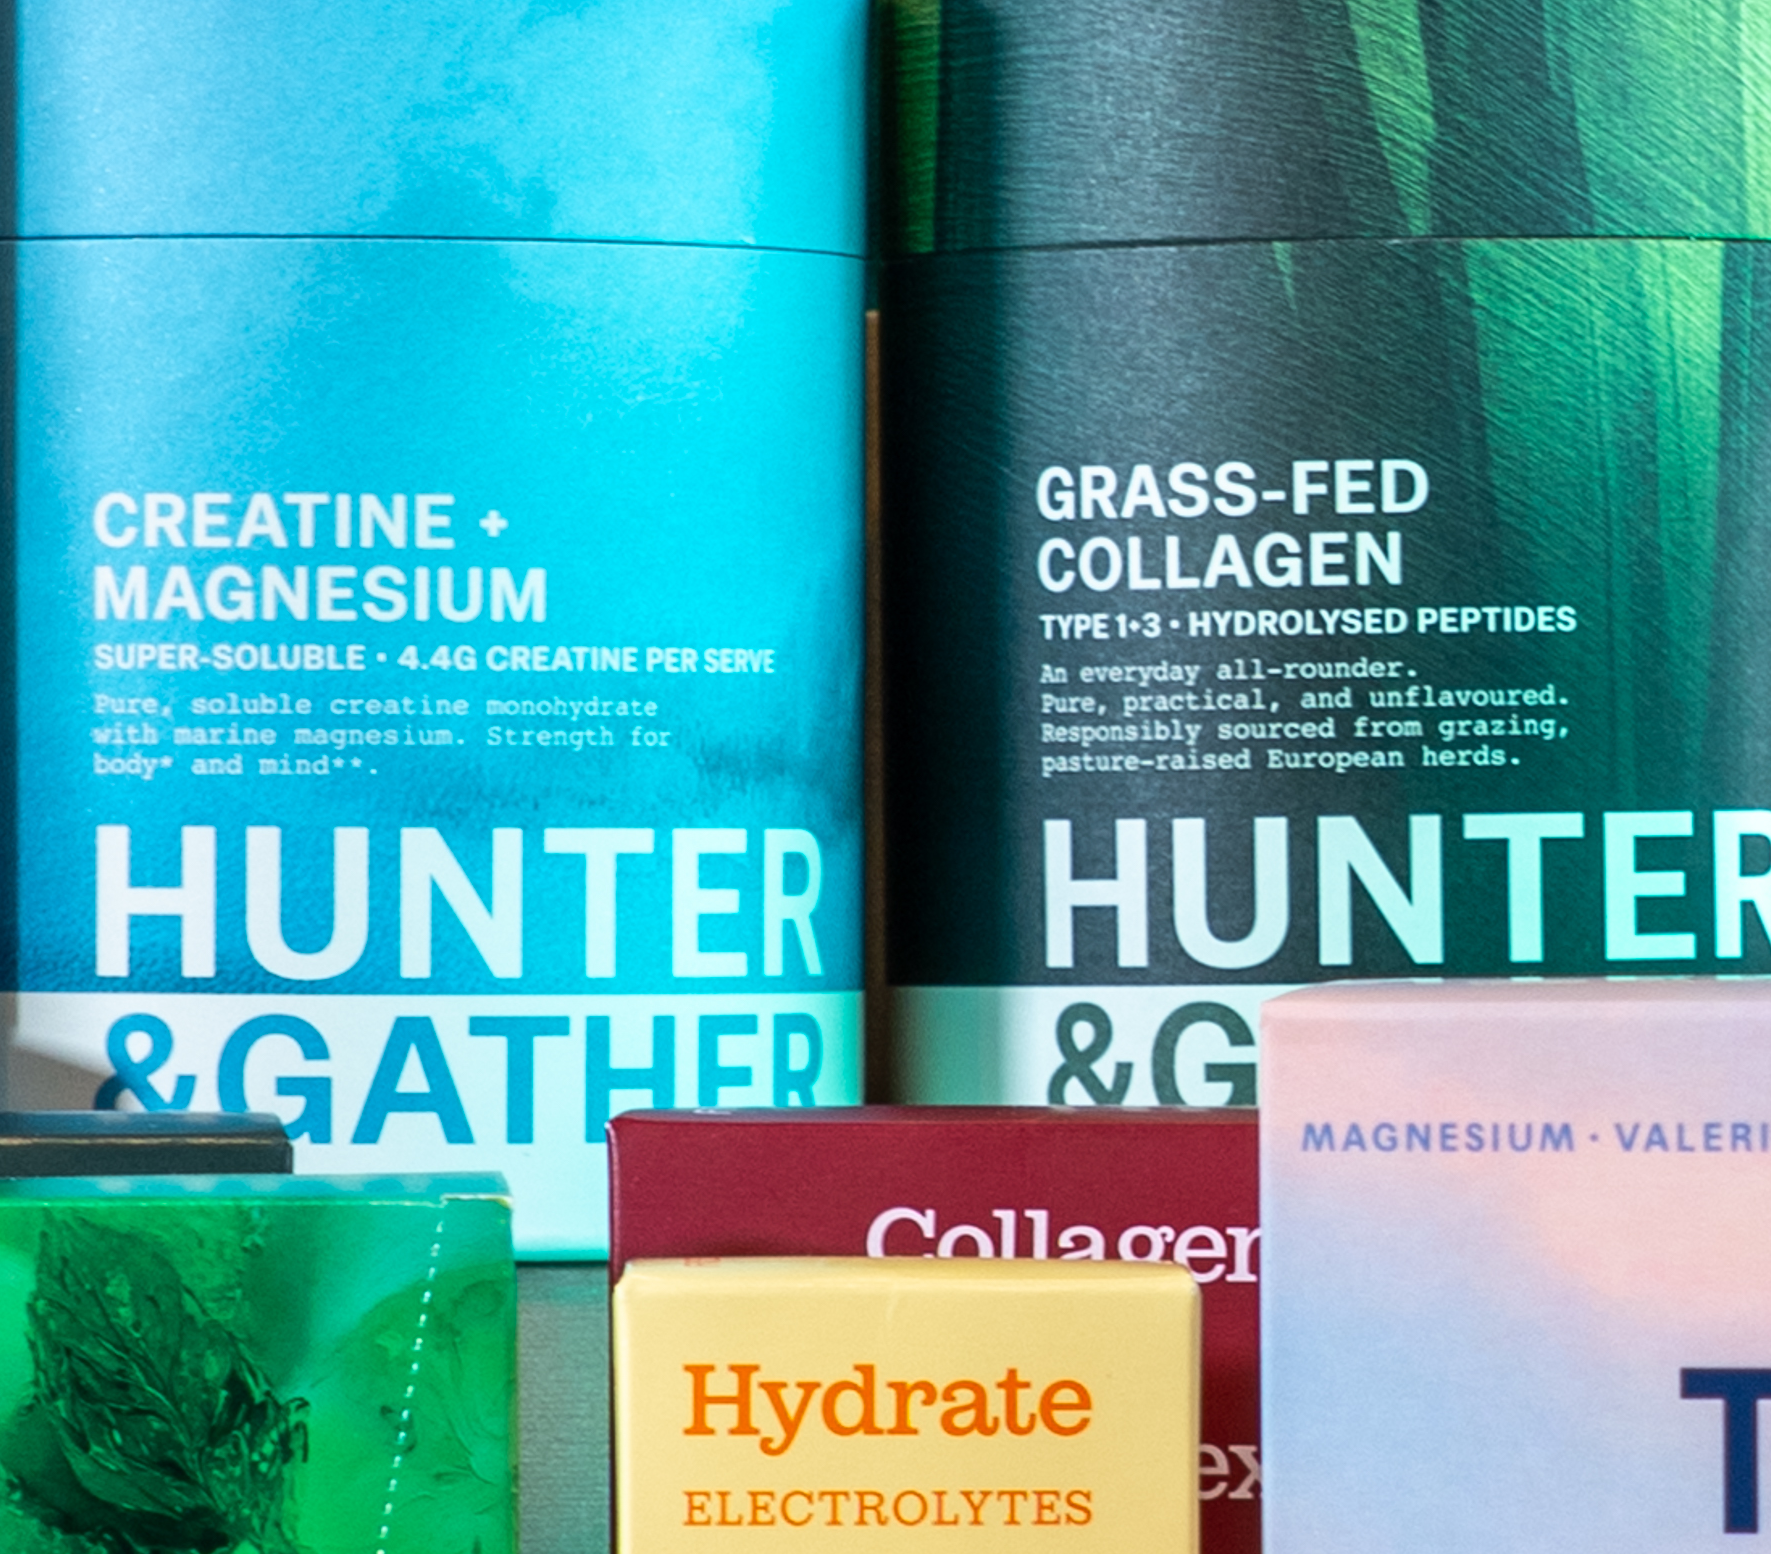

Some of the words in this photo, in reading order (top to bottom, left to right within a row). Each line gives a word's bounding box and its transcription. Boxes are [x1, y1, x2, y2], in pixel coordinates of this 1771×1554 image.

[1036, 459, 1429, 519] GRASS-FED
[93, 492, 455, 550] CREATINE
[1037, 530, 1404, 592] COLLAGEN
[93, 565, 547, 623] MAGNESIUM
[1040, 613, 1111, 640] TYPE
[1189, 607, 1408, 638] HYDROLYSED
[1417, 605, 1577, 634] PEPTIDES
[93, 644, 366, 672] SUPER-SOLUBLE
[486, 645, 638, 672] CREATINE
[645, 646, 698, 673] PER
[703, 649, 775, 673] SERVE
[1081, 663, 1201, 686] everyday
[1216, 659, 1418, 681] all-rounder.
[191, 693, 311, 716] soluble
[329, 694, 469, 716] creatine
[486, 695, 658, 722] monohydrate
[1124, 689, 1281, 716] practical,
[1301, 688, 1352, 709] and
[1369, 685, 1569, 708] unflavoured.
[174, 723, 277, 745] marine
[294, 723, 467, 751] magnesium.
[486, 725, 613, 752] Strength
[1041, 721, 1201, 746] Responsibly
[1217, 718, 1336, 740] sourced
[1354, 716, 1423, 737] from
[1439, 715, 1570, 741] grazing,
[1041, 750, 1251, 777] pasture-raised
[1267, 748, 1405, 773] European
[1422, 745, 1521, 767] herds.
[95, 824, 824, 980] HUNTER
[93, 1011, 824, 1145] &GATHER
[1302, 1122, 1576, 1153] MAGNESIUM
[682, 1364, 1094, 1456] Hydrate
[682, 1489, 1094, 1527] ELECTROLYTES
